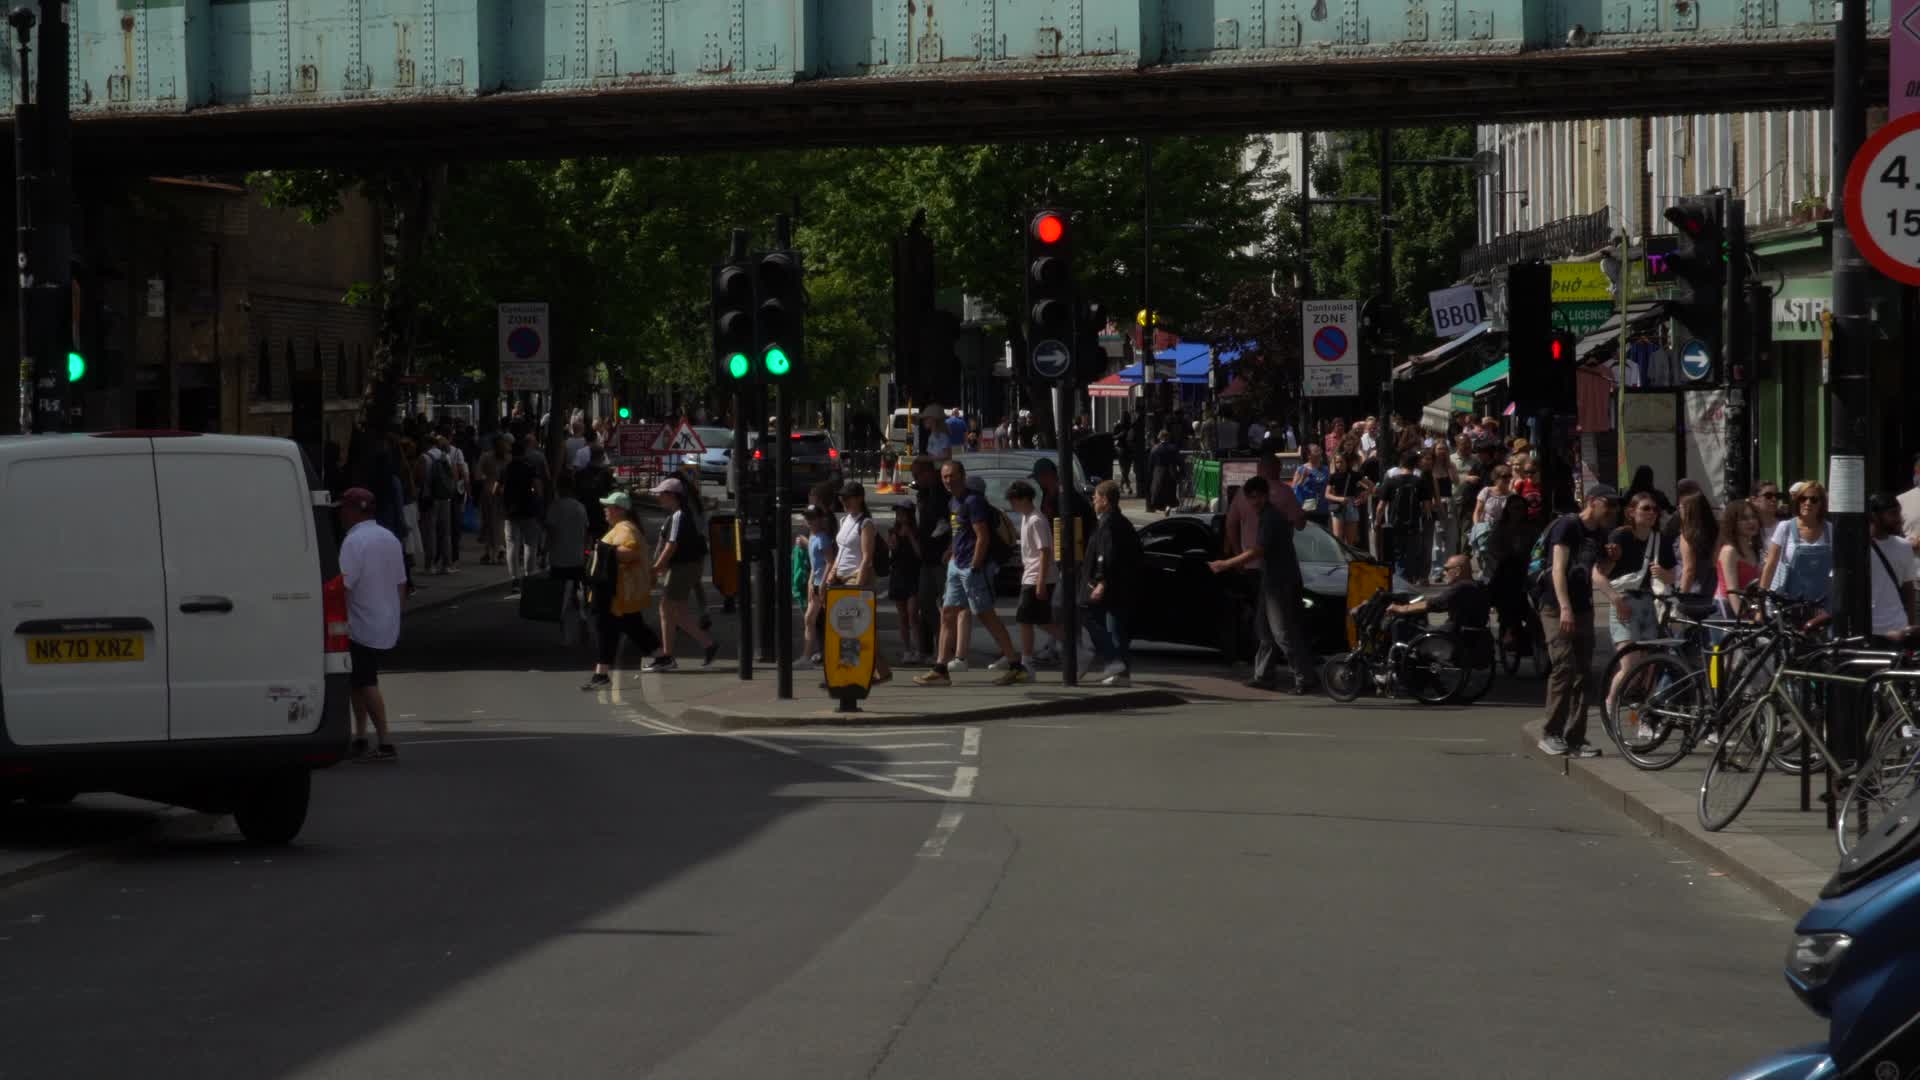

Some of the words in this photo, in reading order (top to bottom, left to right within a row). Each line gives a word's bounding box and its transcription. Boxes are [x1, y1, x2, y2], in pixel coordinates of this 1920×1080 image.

[1306, 303, 1353, 312] Controlled
[1312, 313, 1346, 324] ZONE
[1436, 303, 1476, 329] BBQ
[1569, 309, 1610, 320] LICENCE
[36, 639, 89, 658] NK70
